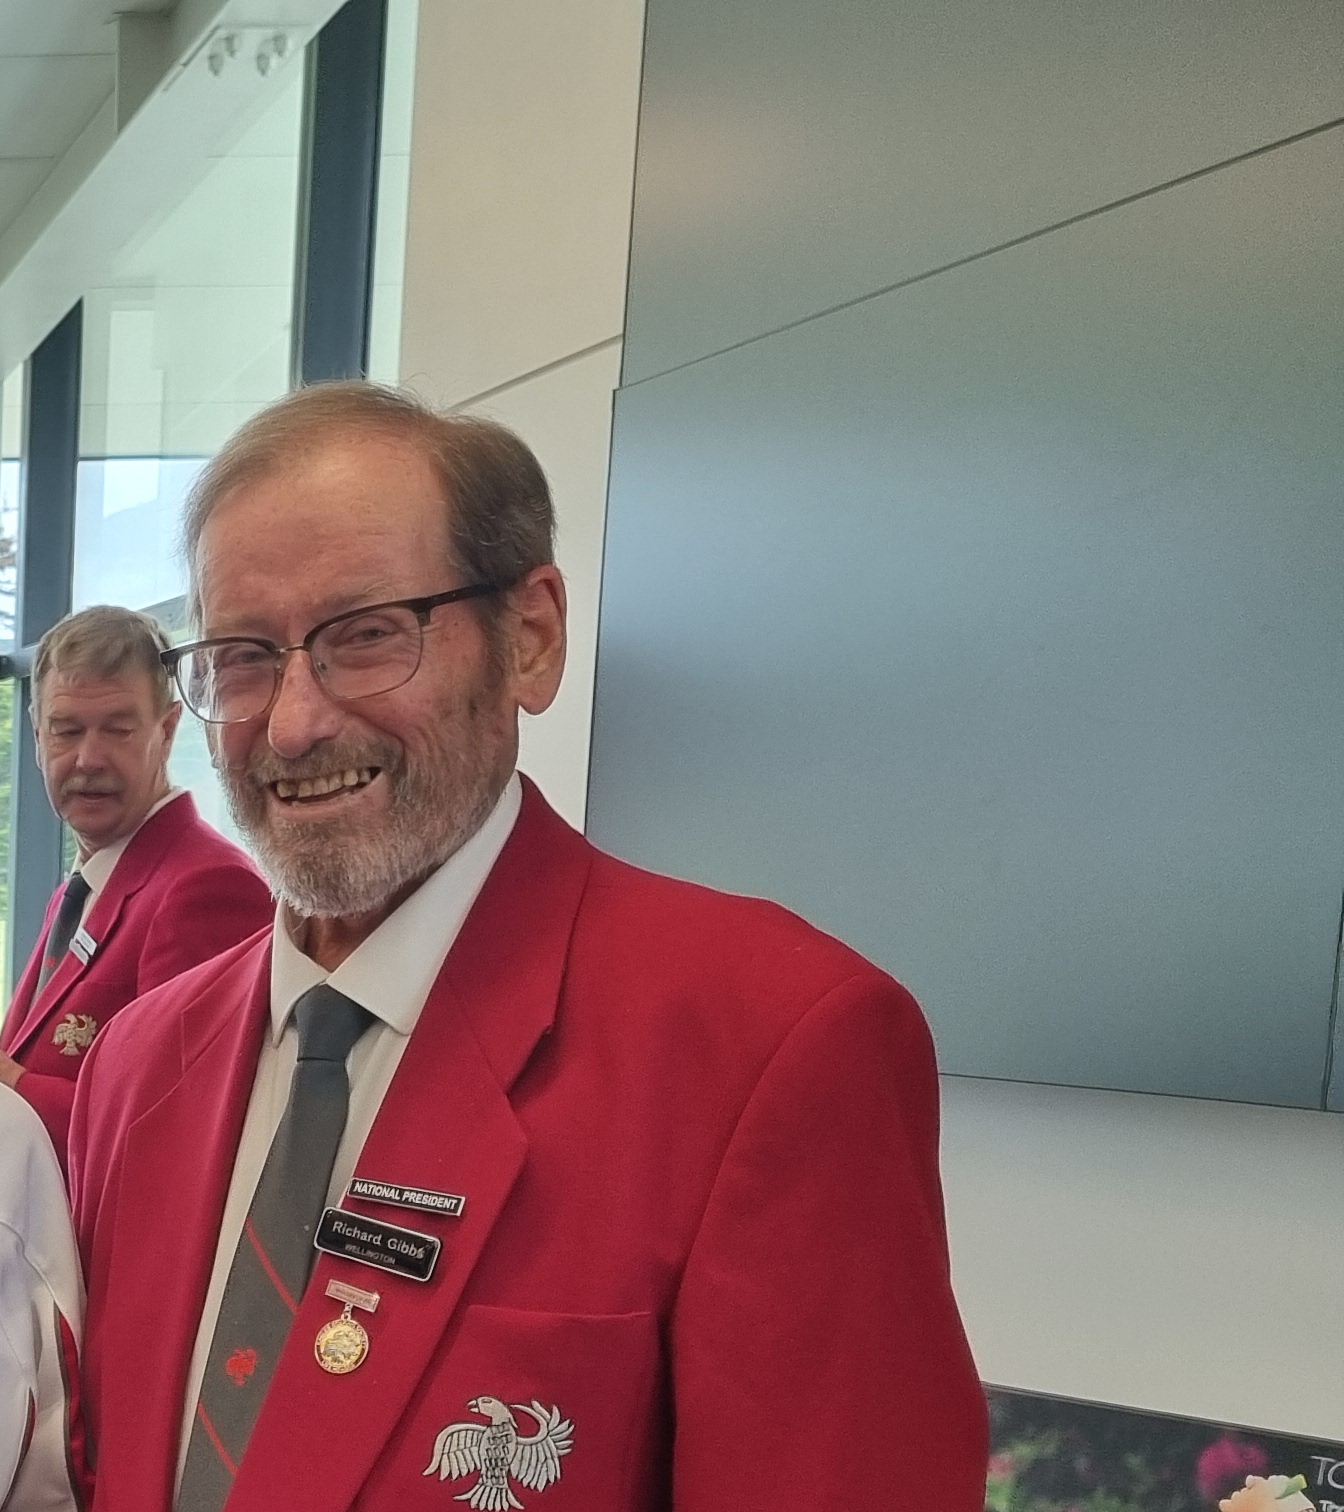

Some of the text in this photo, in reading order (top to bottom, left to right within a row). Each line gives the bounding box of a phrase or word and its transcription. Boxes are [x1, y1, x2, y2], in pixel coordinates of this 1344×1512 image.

[353, 1181, 458, 1210] NATIONAL PRESIDENT
[332, 1221, 425, 1259] Richard Gibbs
[344, 1243, 396, 1264] WELLINGTON
